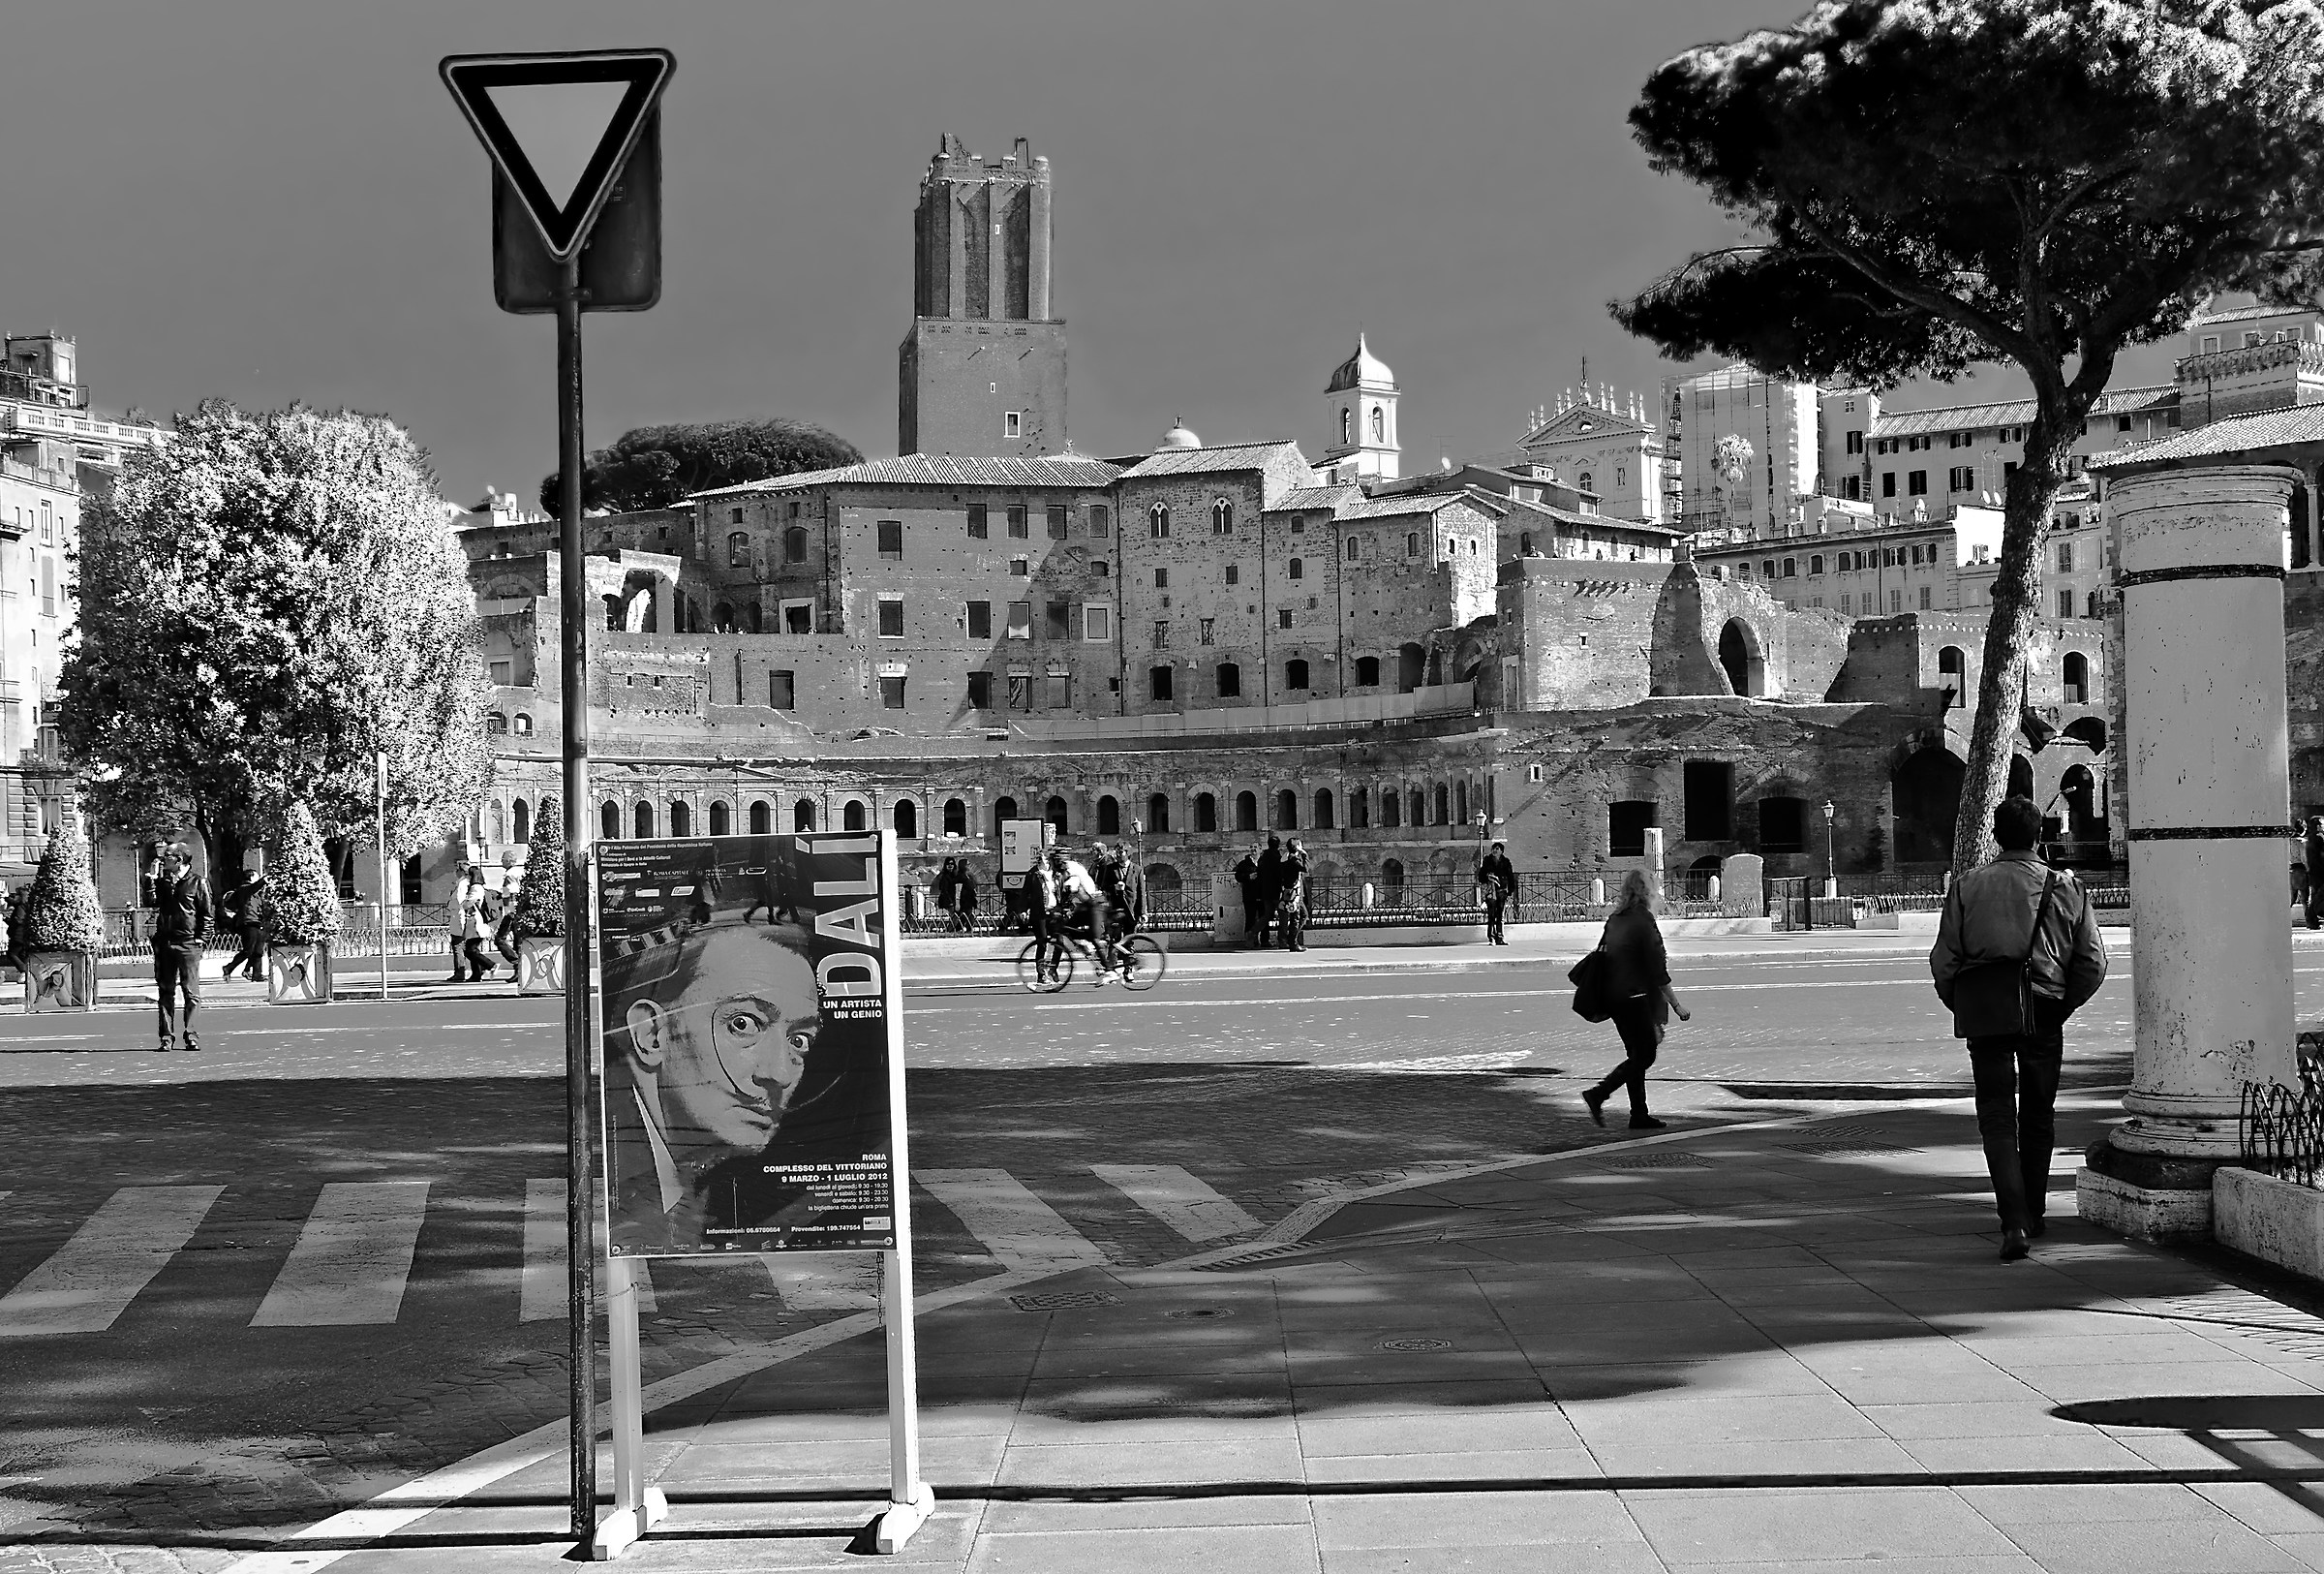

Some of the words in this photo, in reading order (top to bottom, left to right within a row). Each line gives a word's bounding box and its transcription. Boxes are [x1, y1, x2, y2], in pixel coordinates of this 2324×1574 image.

[795, 834, 882, 997] DALÍ
[823, 1001, 839, 1009] UN
[841, 999, 882, 1008] ARTISTA
[833, 1010, 849, 1019] UN
[851, 1009, 882, 1019] GENIO
[763, 1164, 815, 1173] COMPLESSO
[816, 1163, 834, 1172] DEL
[835, 1162, 888, 1171] VITTORIANO
[788, 1174, 820, 1183] MARZO
[834, 1173, 866, 1182] LUGLIO
[868, 1172, 889, 1181] 2012
